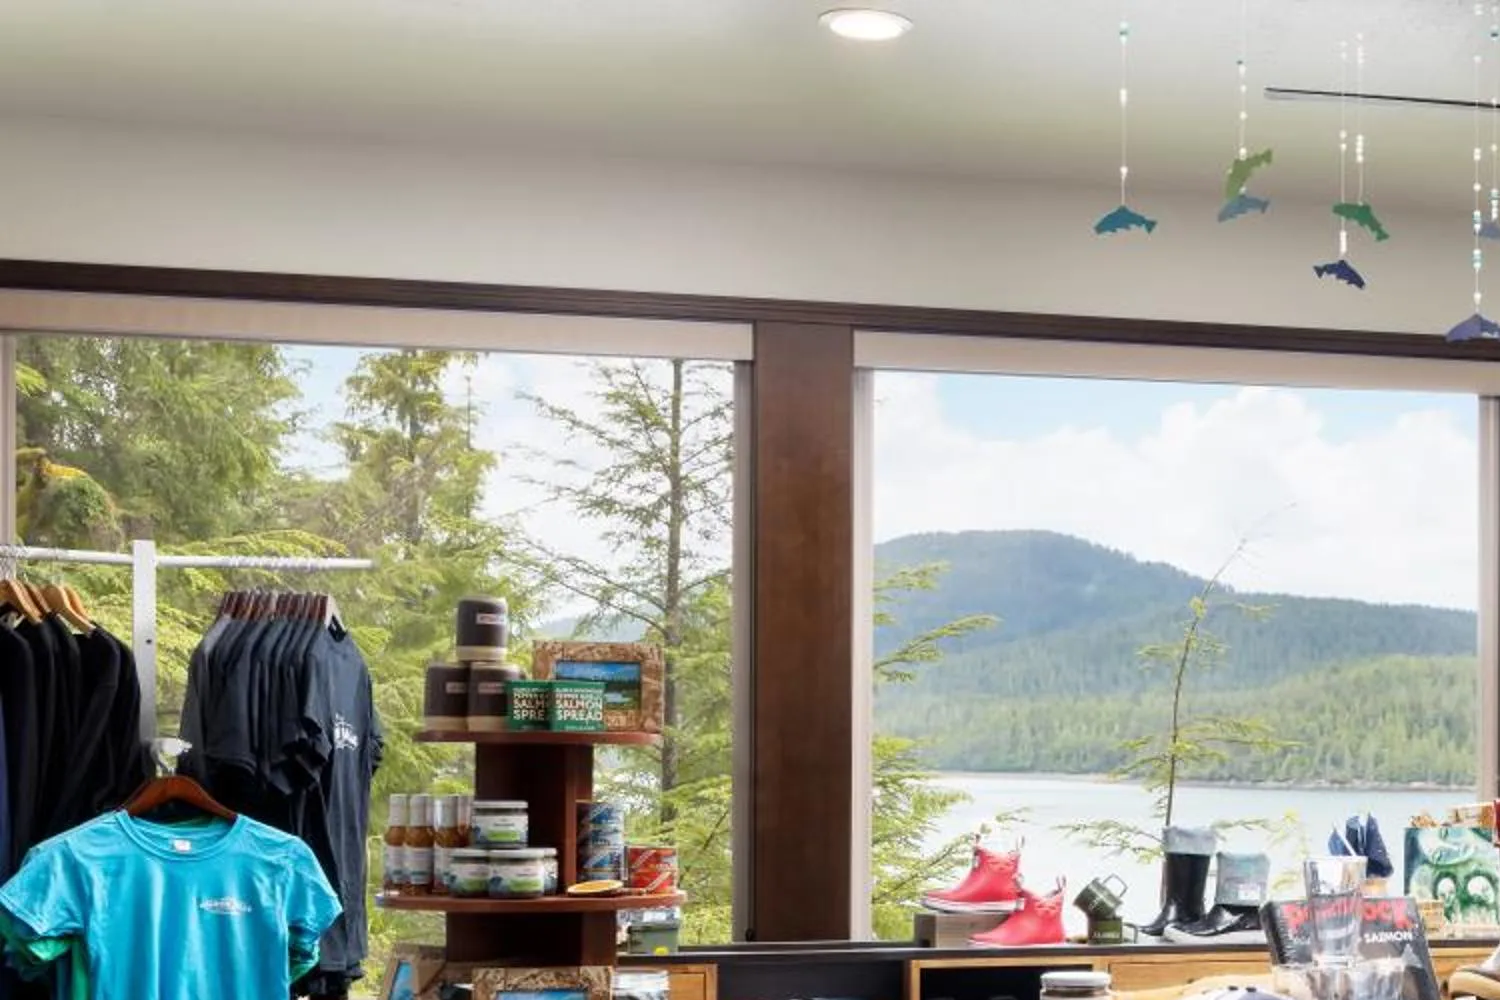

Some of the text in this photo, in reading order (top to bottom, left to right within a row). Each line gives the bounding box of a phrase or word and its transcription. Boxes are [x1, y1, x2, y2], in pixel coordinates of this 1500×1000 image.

[513, 699, 545, 709] SALM
[555, 699, 603, 710] SALMON
[513, 709, 545, 721] SPRE
[555, 709, 603, 721] SPREAD
